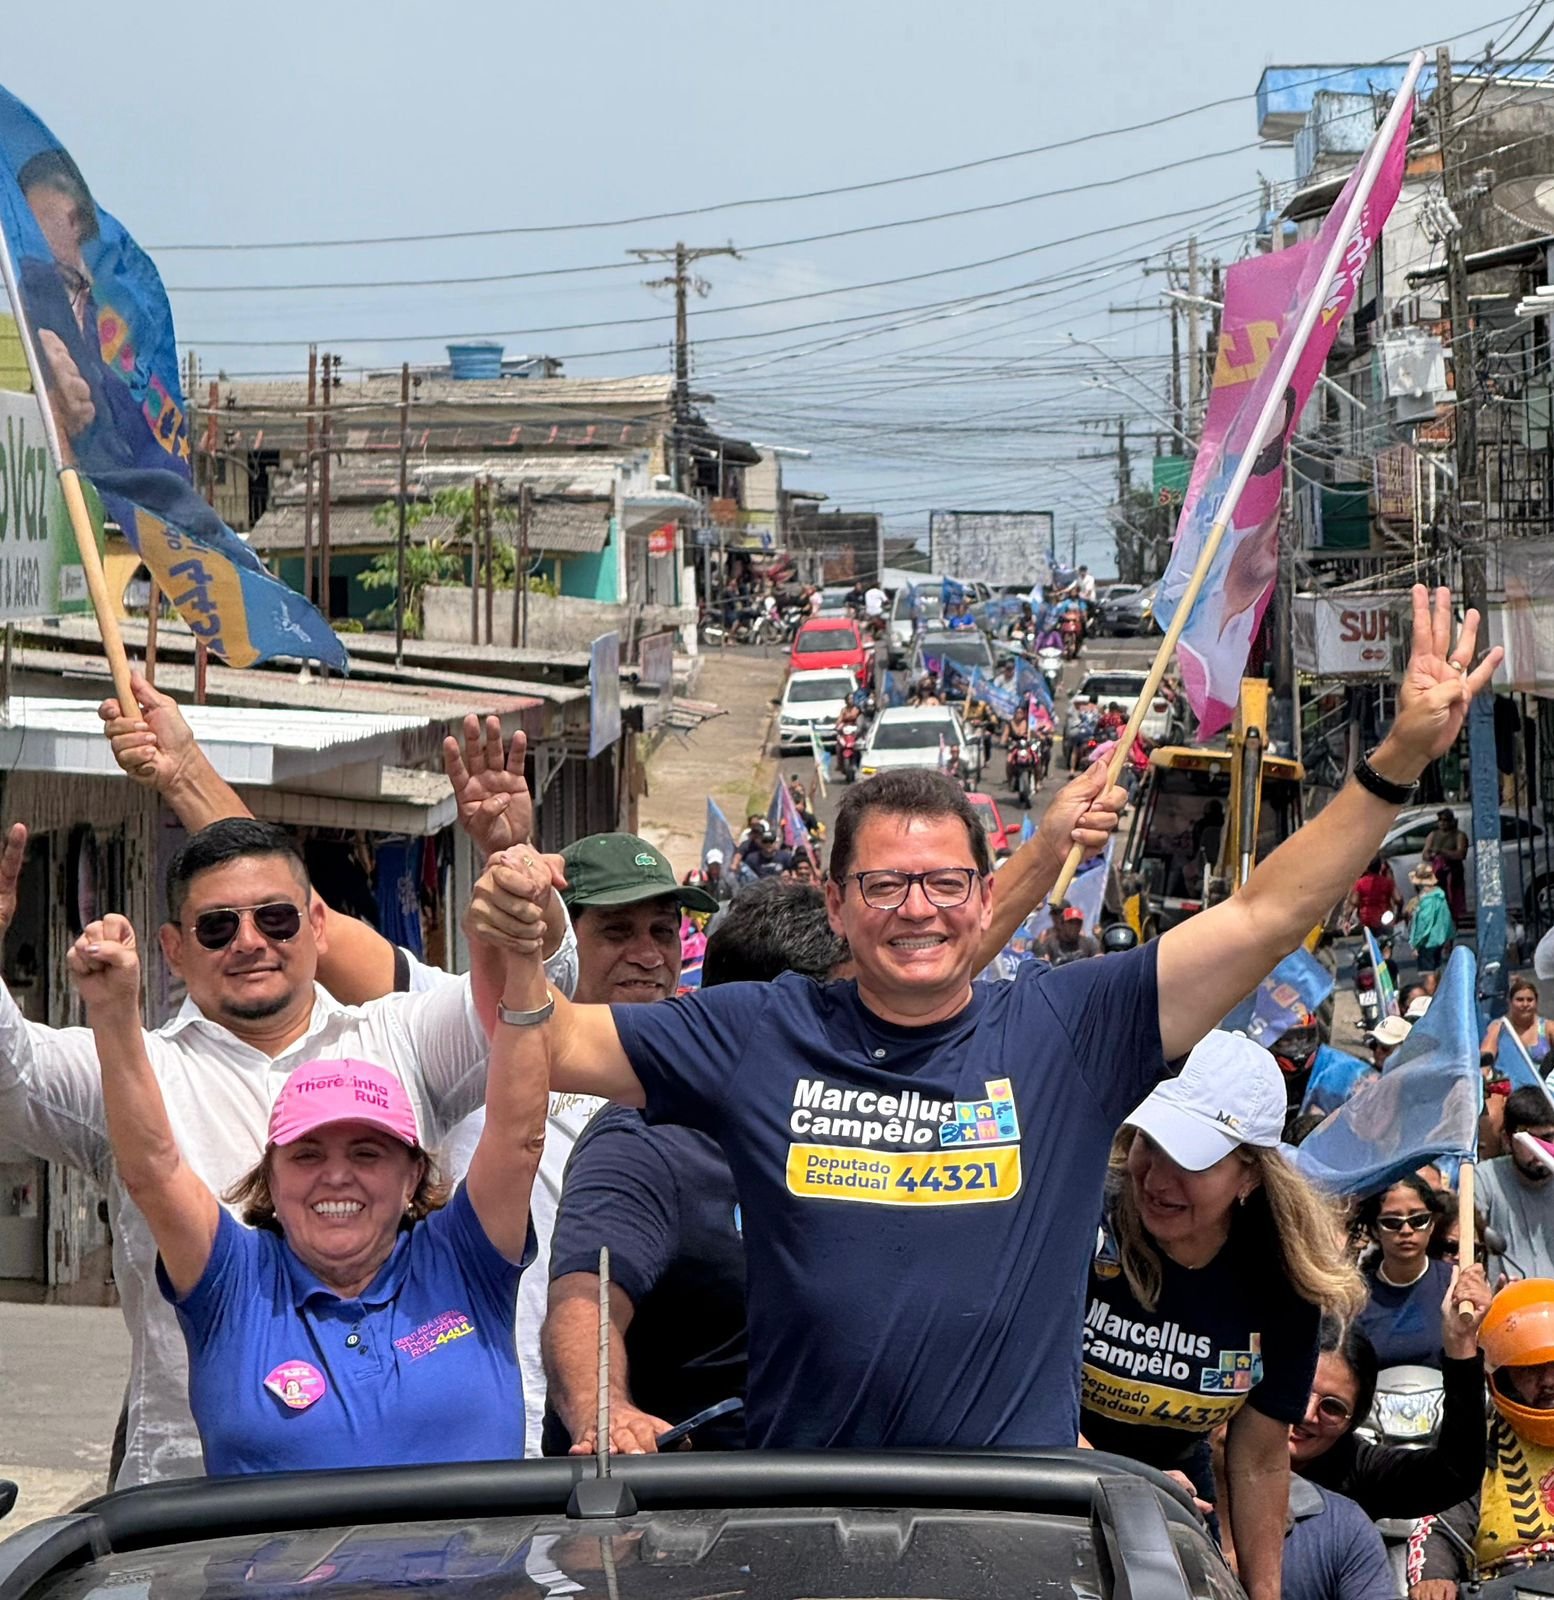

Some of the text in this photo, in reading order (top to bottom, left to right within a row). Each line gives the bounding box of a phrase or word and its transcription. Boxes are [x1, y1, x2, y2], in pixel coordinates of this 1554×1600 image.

[14, 556, 41, 608] AGRO
[354, 1089, 390, 1109] Ruiz
[792, 1079, 955, 1123] Marcellus
[790, 1109, 933, 1145] Campêlo
[805, 1169, 888, 1190] Estadual
[807, 1154, 999, 1193] Deputado 44321
[1084, 1298, 1212, 1359] Marcellus
[1081, 1387, 1146, 1417] stadual
